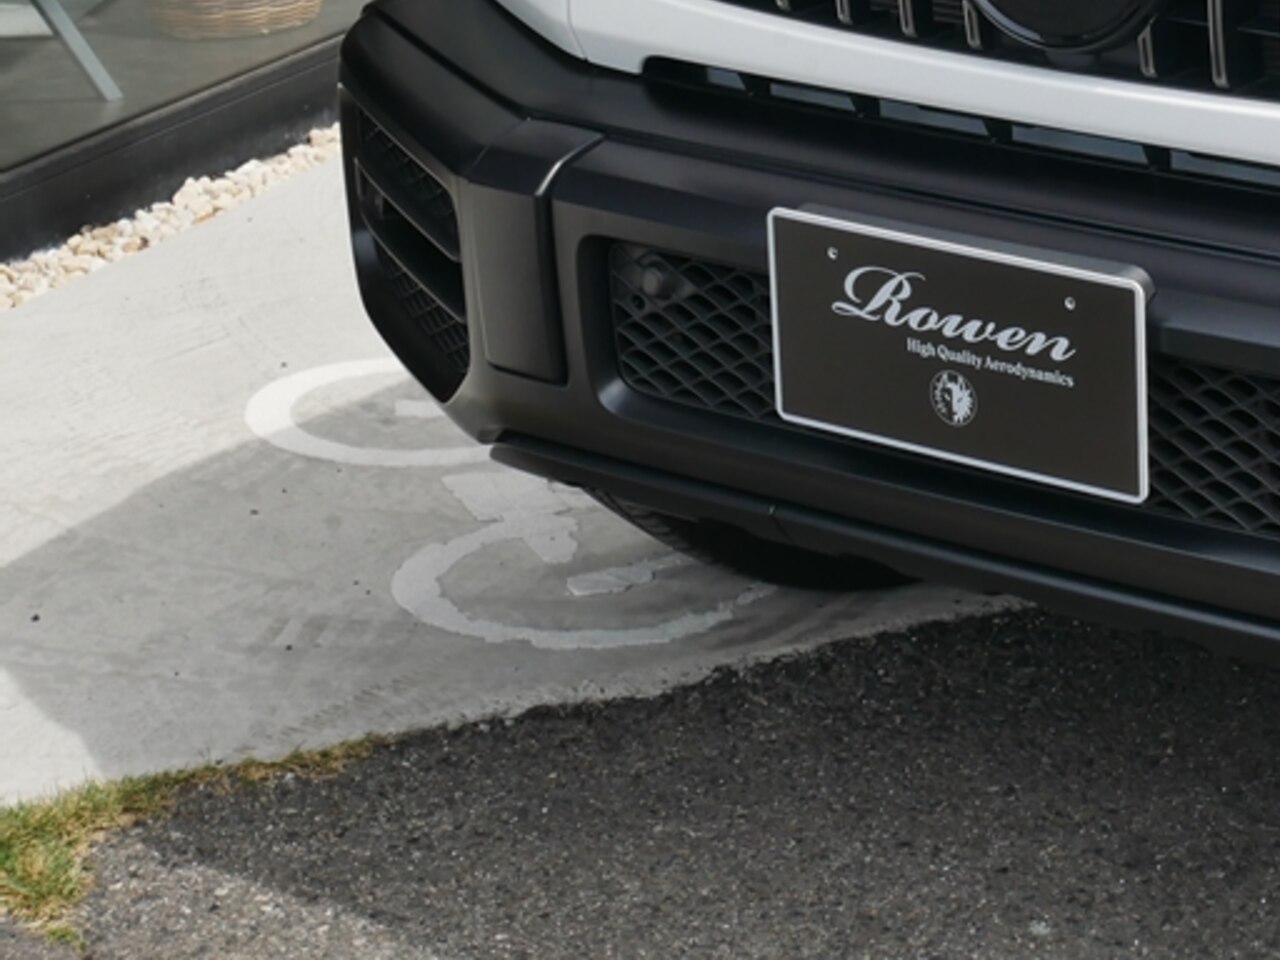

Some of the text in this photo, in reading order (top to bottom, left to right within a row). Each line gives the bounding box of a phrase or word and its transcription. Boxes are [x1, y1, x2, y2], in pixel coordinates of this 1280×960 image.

[831, 265, 1076, 362] Rowen
[906, 337, 1074, 388] High Quality Aerodynamics
